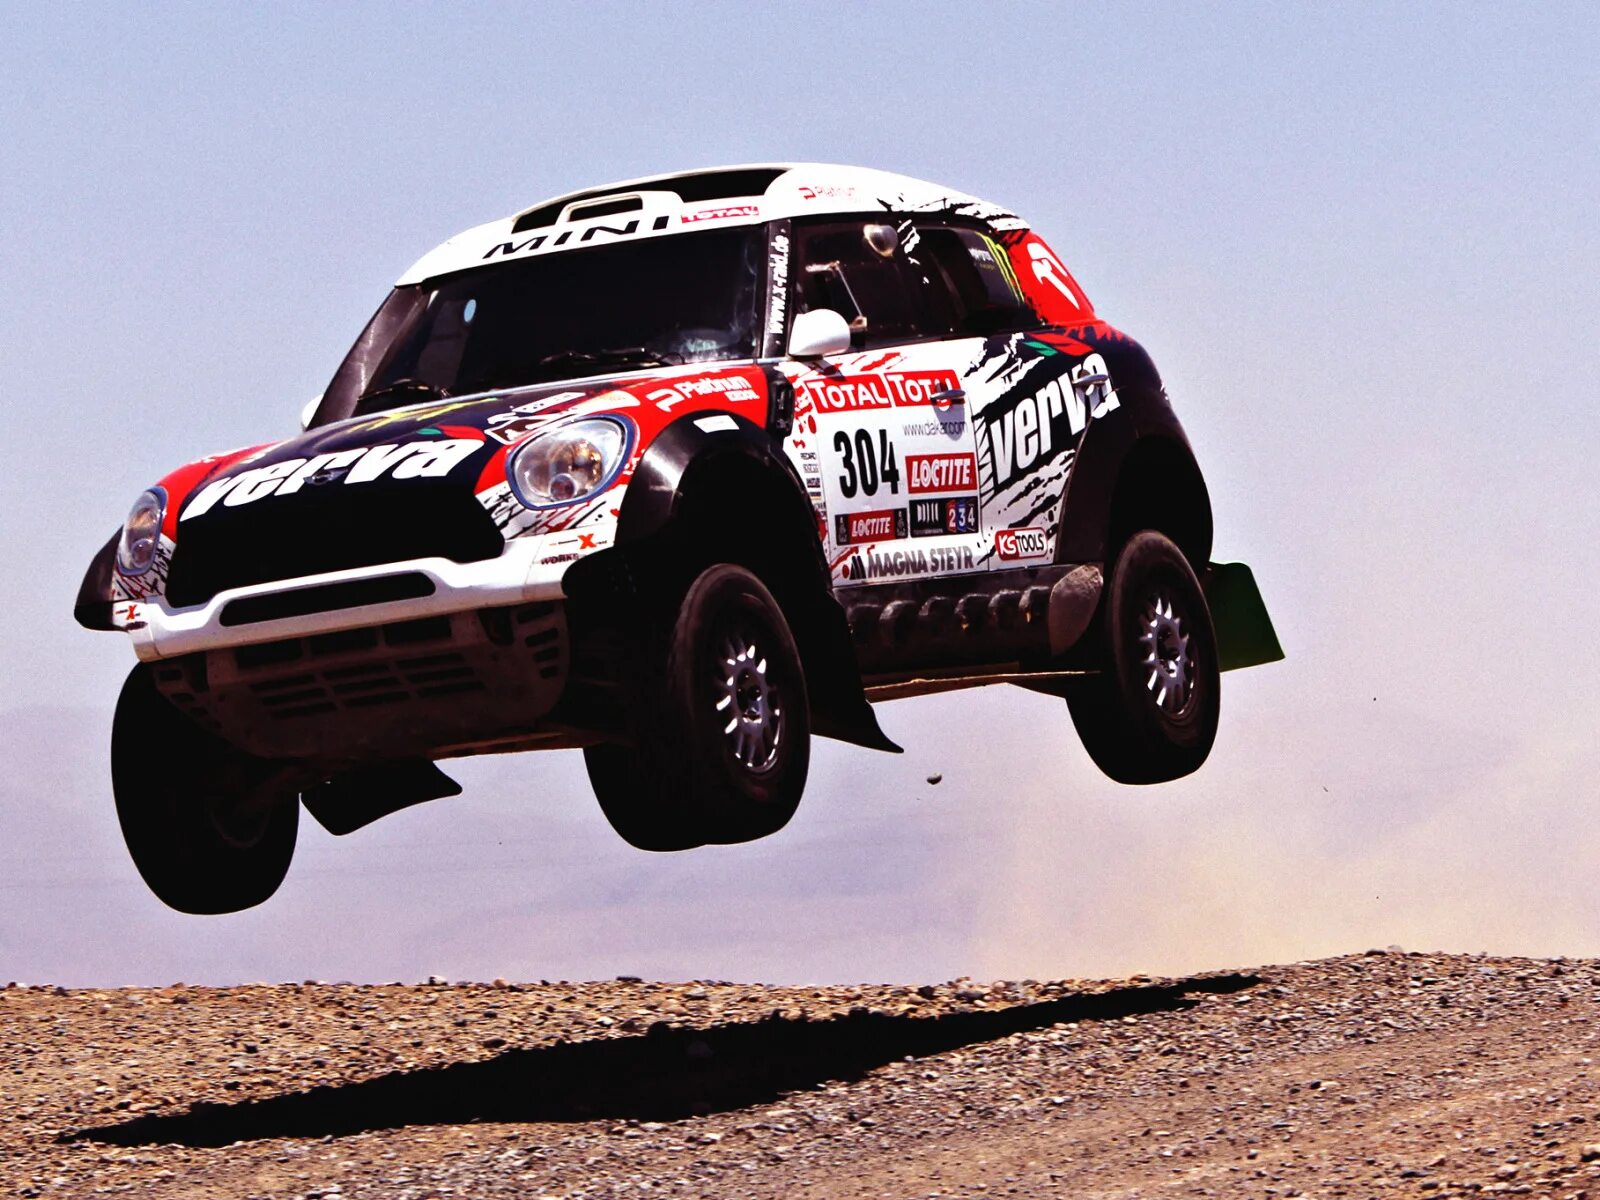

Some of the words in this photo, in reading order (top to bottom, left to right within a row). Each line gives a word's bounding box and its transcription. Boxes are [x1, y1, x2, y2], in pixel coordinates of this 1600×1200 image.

[684, 206, 759, 222] TOTAL
[482, 215, 670, 259] MINI
[769, 235, 790, 334] www.x-raid.de
[674, 376, 752, 398] Platinum
[807, 381, 890, 409] TOTAL
[990, 353, 1121, 485] verva
[834, 429, 899, 498] 304
[911, 458, 972, 487] LOCTITE
[181, 439, 485, 520] verva
[851, 516, 891, 538] LOCTITE
[998, 535, 1017, 555] KS
[1015, 533, 1045, 553] TOOLS
[868, 551, 929, 578] MAGNA
[930, 545, 974, 575] STEYR
